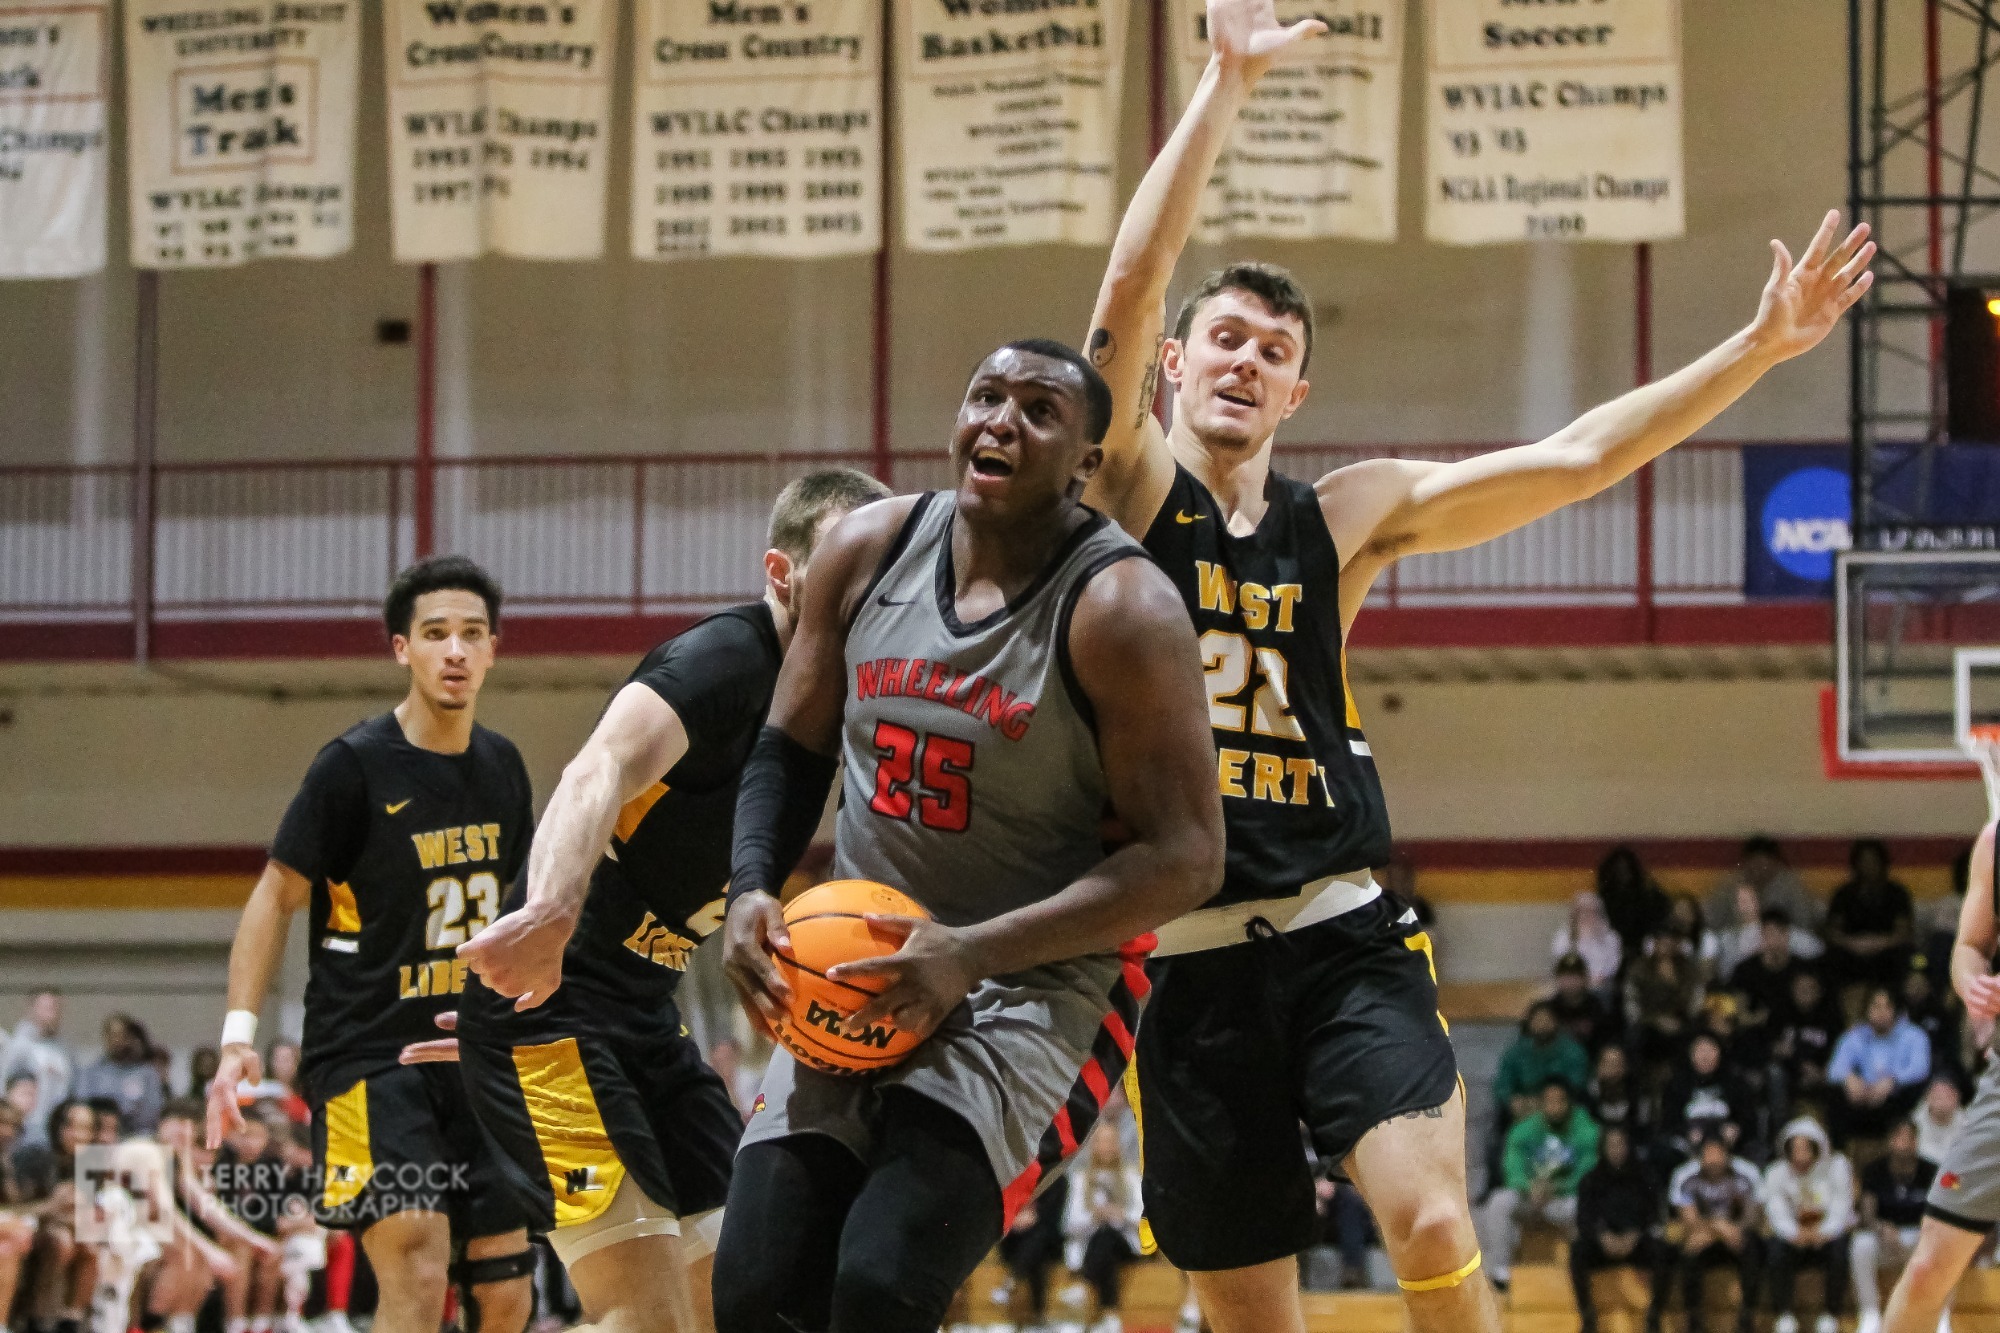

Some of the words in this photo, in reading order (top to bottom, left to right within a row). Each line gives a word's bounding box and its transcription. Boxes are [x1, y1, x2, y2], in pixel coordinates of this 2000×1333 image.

[740, 33, 863, 63] Country
[1483, 20, 1614, 48] Soccer
[1555, 79, 1668, 112] Champs
[759, 107, 870, 138] Champs
[856, 656, 1037, 742] WHEELING
[870, 718, 976, 833] 25
[411, 823, 501, 870] WEST
[425, 871, 501, 952] 23
